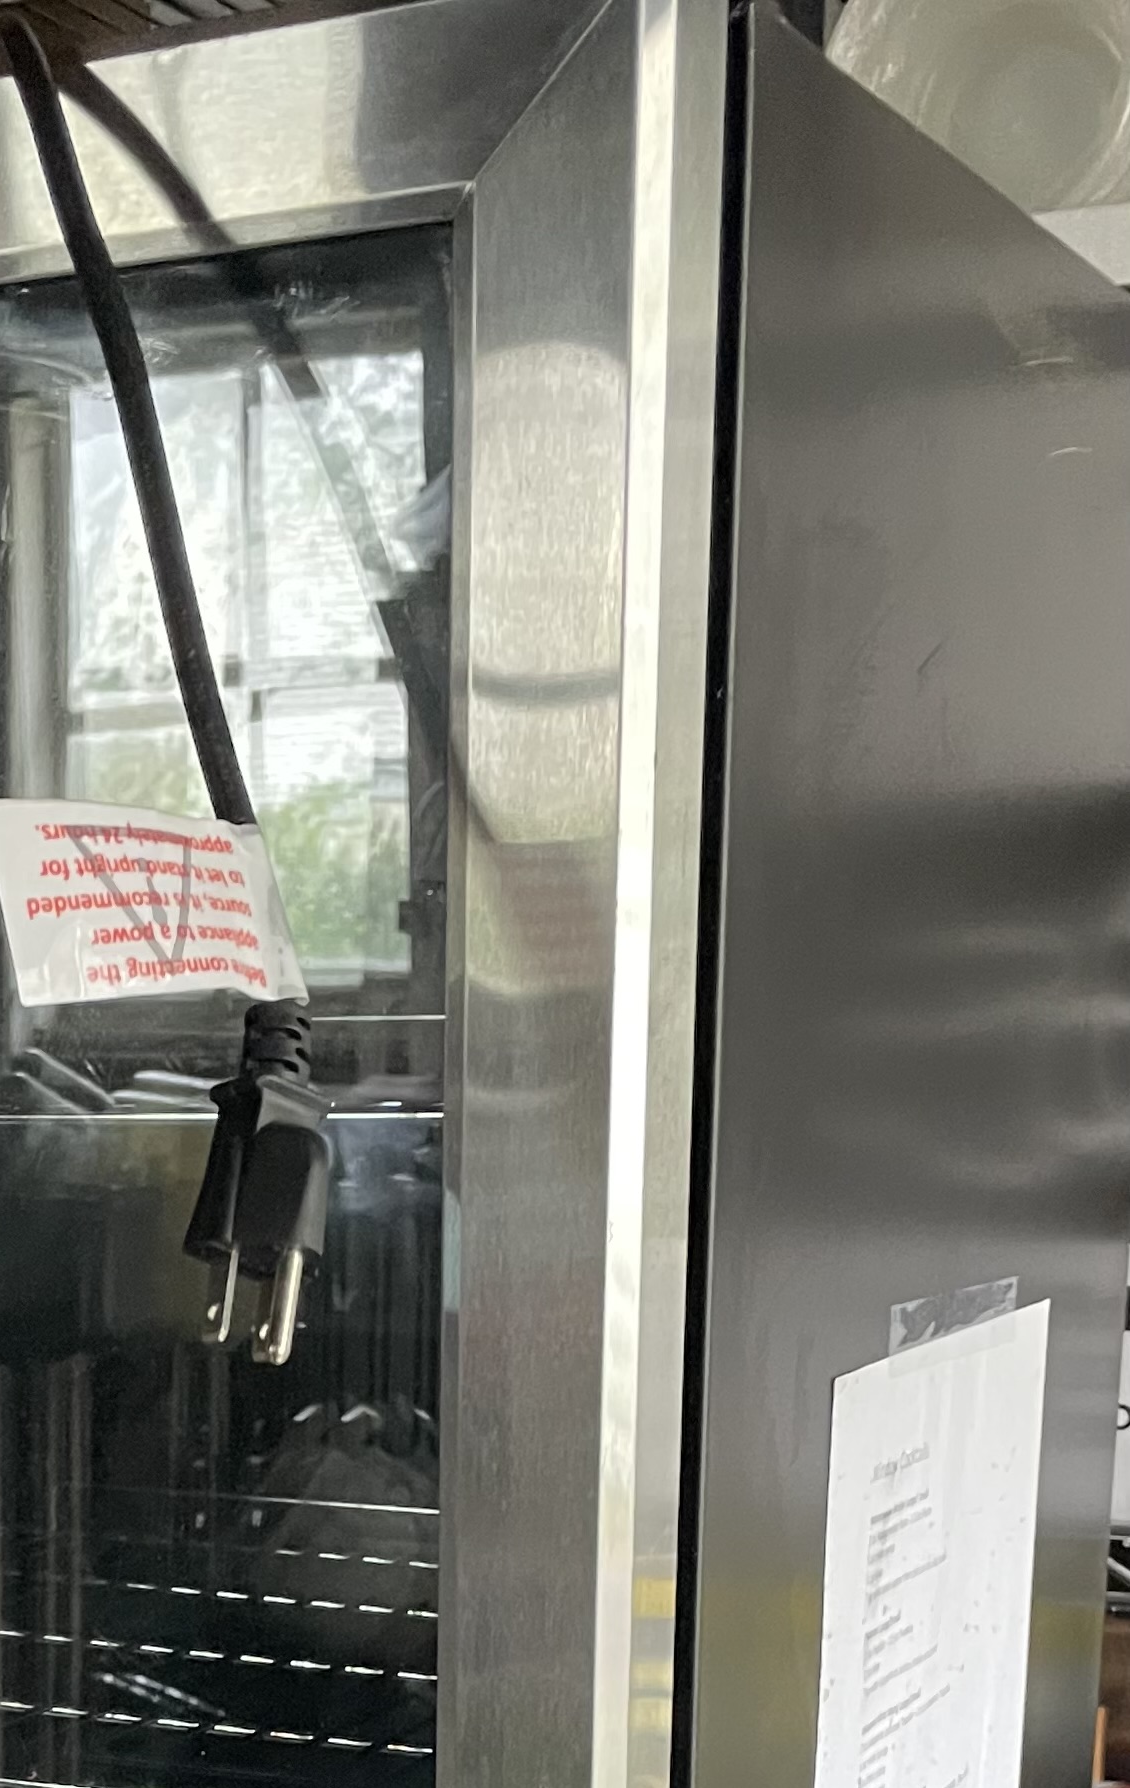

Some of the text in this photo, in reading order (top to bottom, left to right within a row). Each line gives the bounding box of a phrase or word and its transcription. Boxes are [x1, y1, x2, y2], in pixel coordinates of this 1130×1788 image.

[35, 821, 234, 855] approximately 24 hours.
[39, 853, 246, 889] to let it stand upright for
[26, 890, 170, 920] recommended
[190, 893, 203, 913] it
[203, 892, 253, 917] source,
[91, 920, 260, 950] appliance to a power
[86, 962, 122, 986] the
[126, 956, 228, 982] connecting
